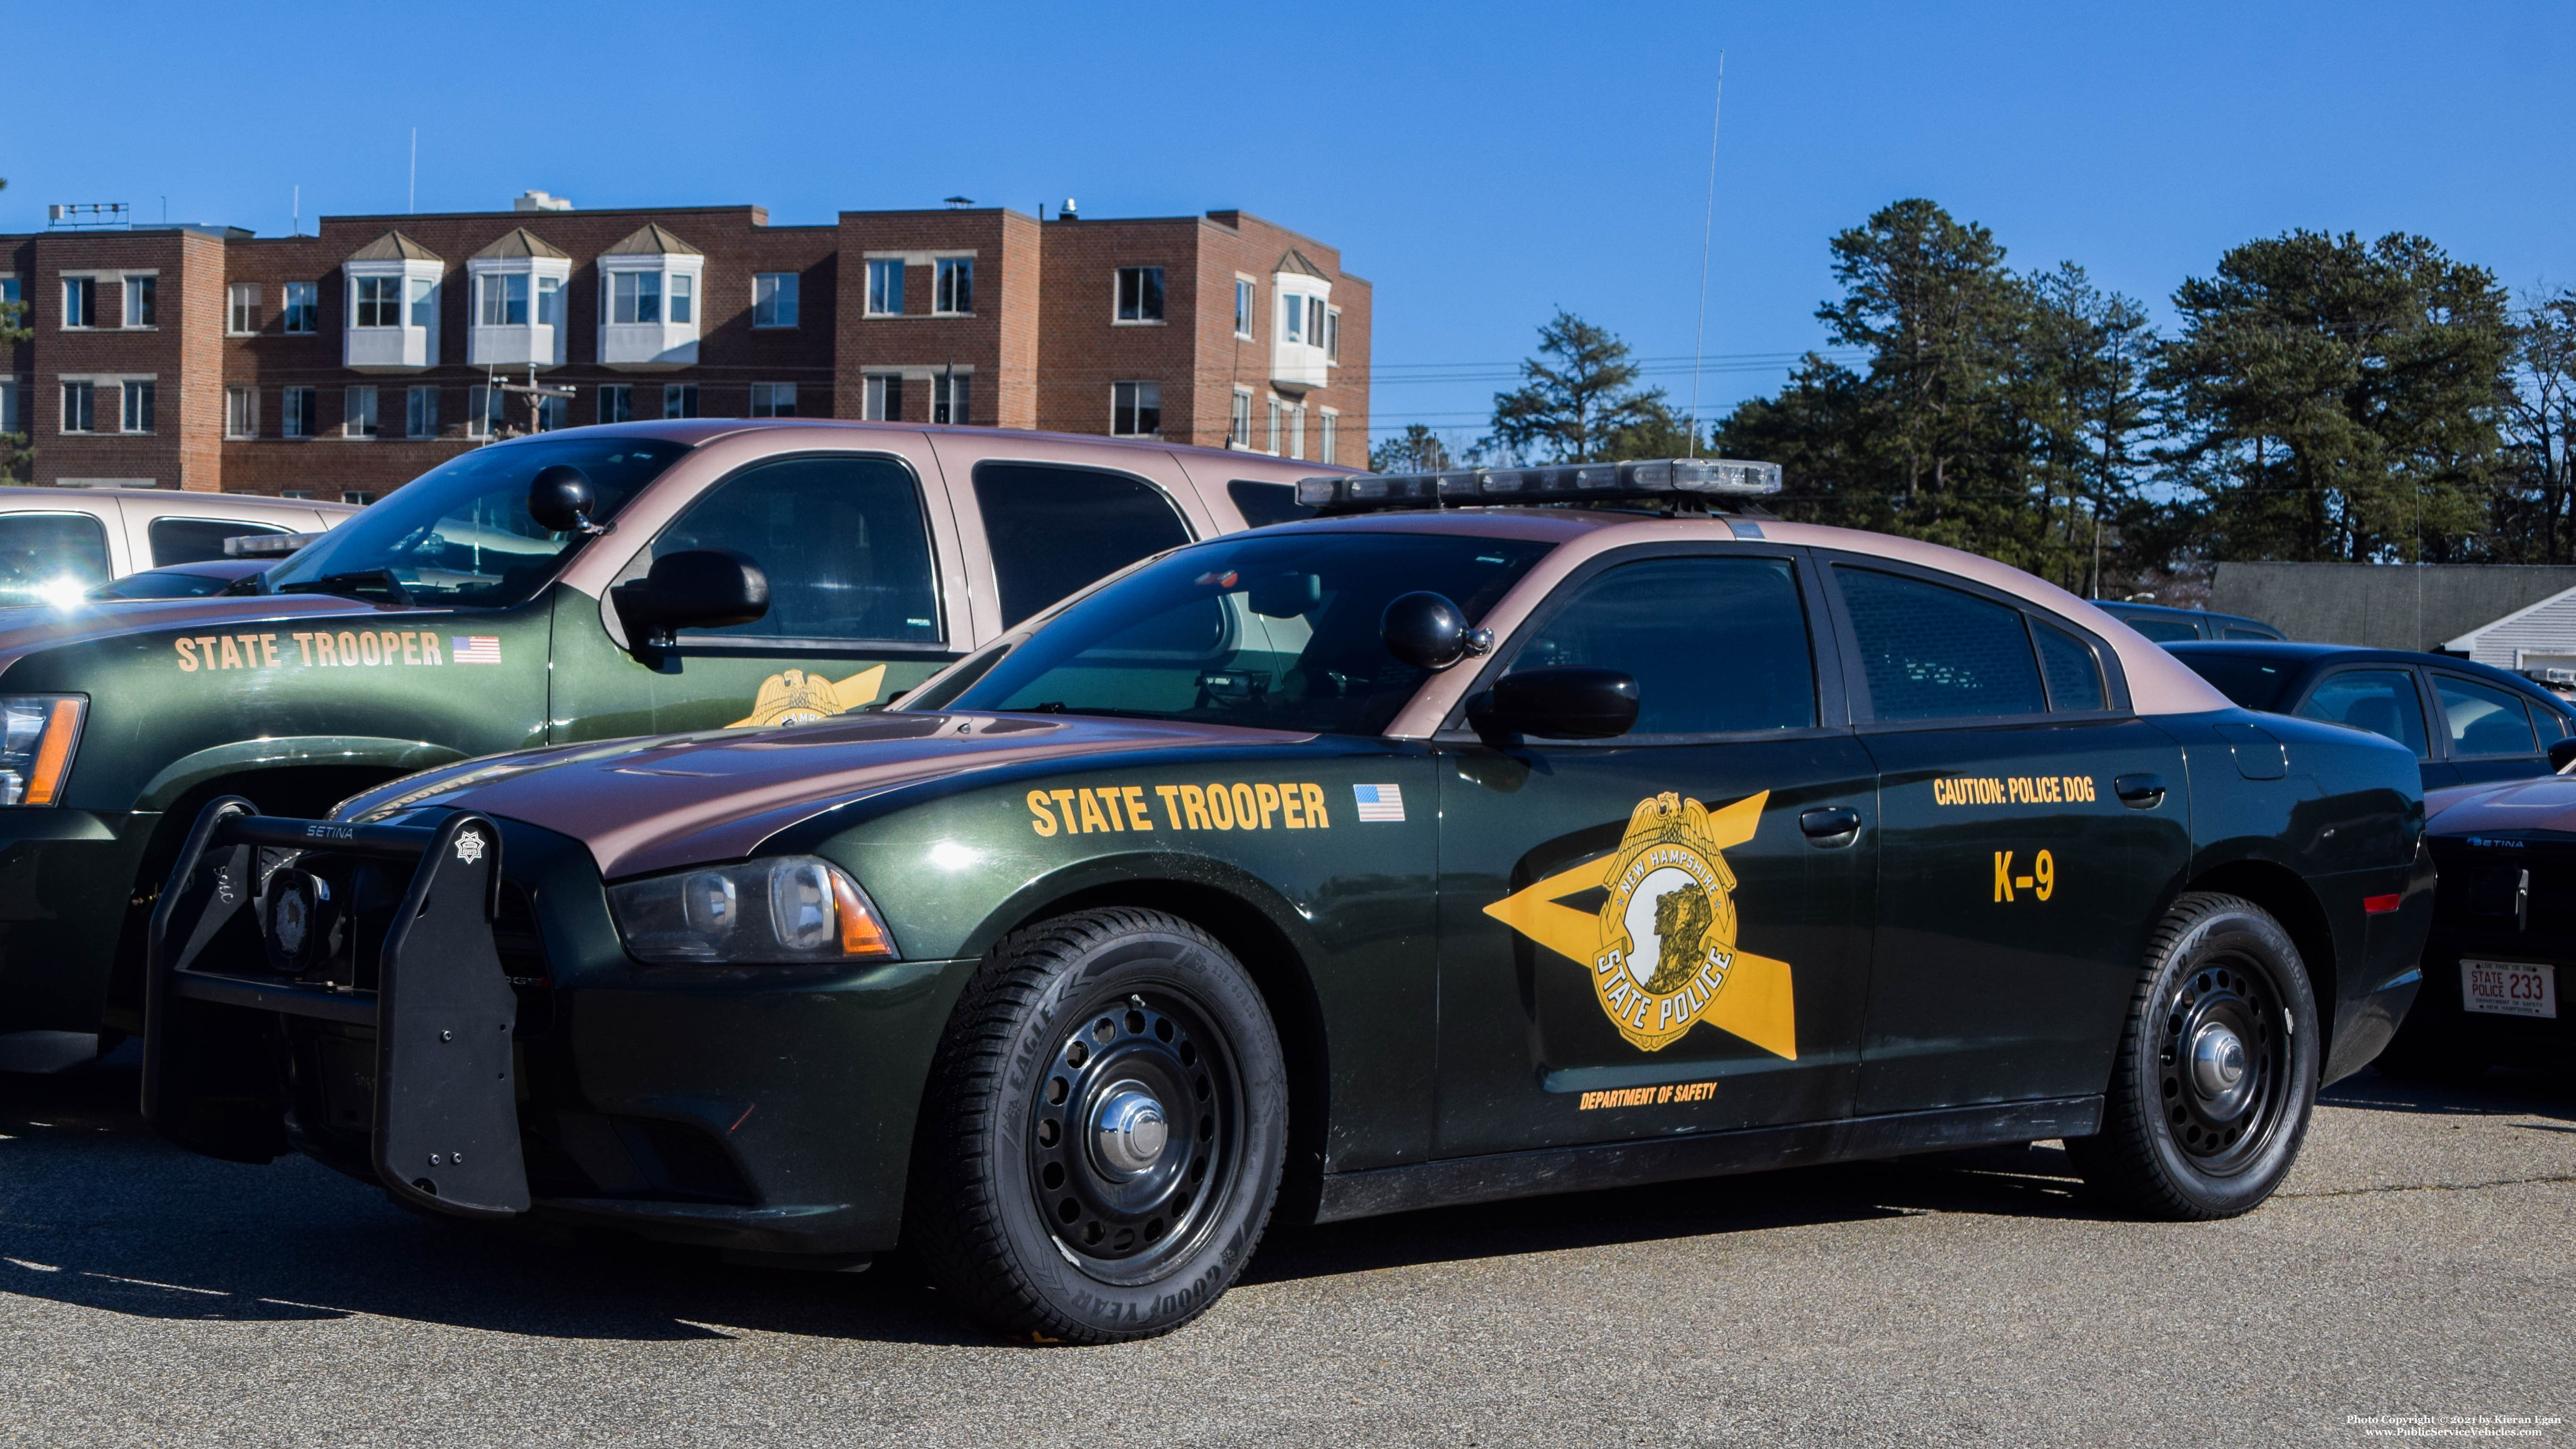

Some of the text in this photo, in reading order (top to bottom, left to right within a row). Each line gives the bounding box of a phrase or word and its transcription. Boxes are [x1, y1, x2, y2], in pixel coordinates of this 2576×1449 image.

[174, 631, 443, 671] STATE TROOPER
[1934, 776, 2095, 805] CAUTION: POLICE DOG
[1027, 783, 1330, 837] STATE TROOPER
[307, 825, 353, 840] SETINA
[2473, 839, 2524, 847] SETINA
[1620, 849, 1719, 896] NEW HAMPSHIRE
[1995, 849, 2054, 902] K-9
[1597, 946, 1733, 1030] STATE POLICE
[2472, 971, 2503, 984] STATE
[2472, 983, 2504, 998] POLICE
[2510, 974, 2543, 1000] 233
[1009, 1001, 1057, 1089] EAGLE
[1580, 1082, 1717, 1110] DEPARTMENT OF SAFETY
